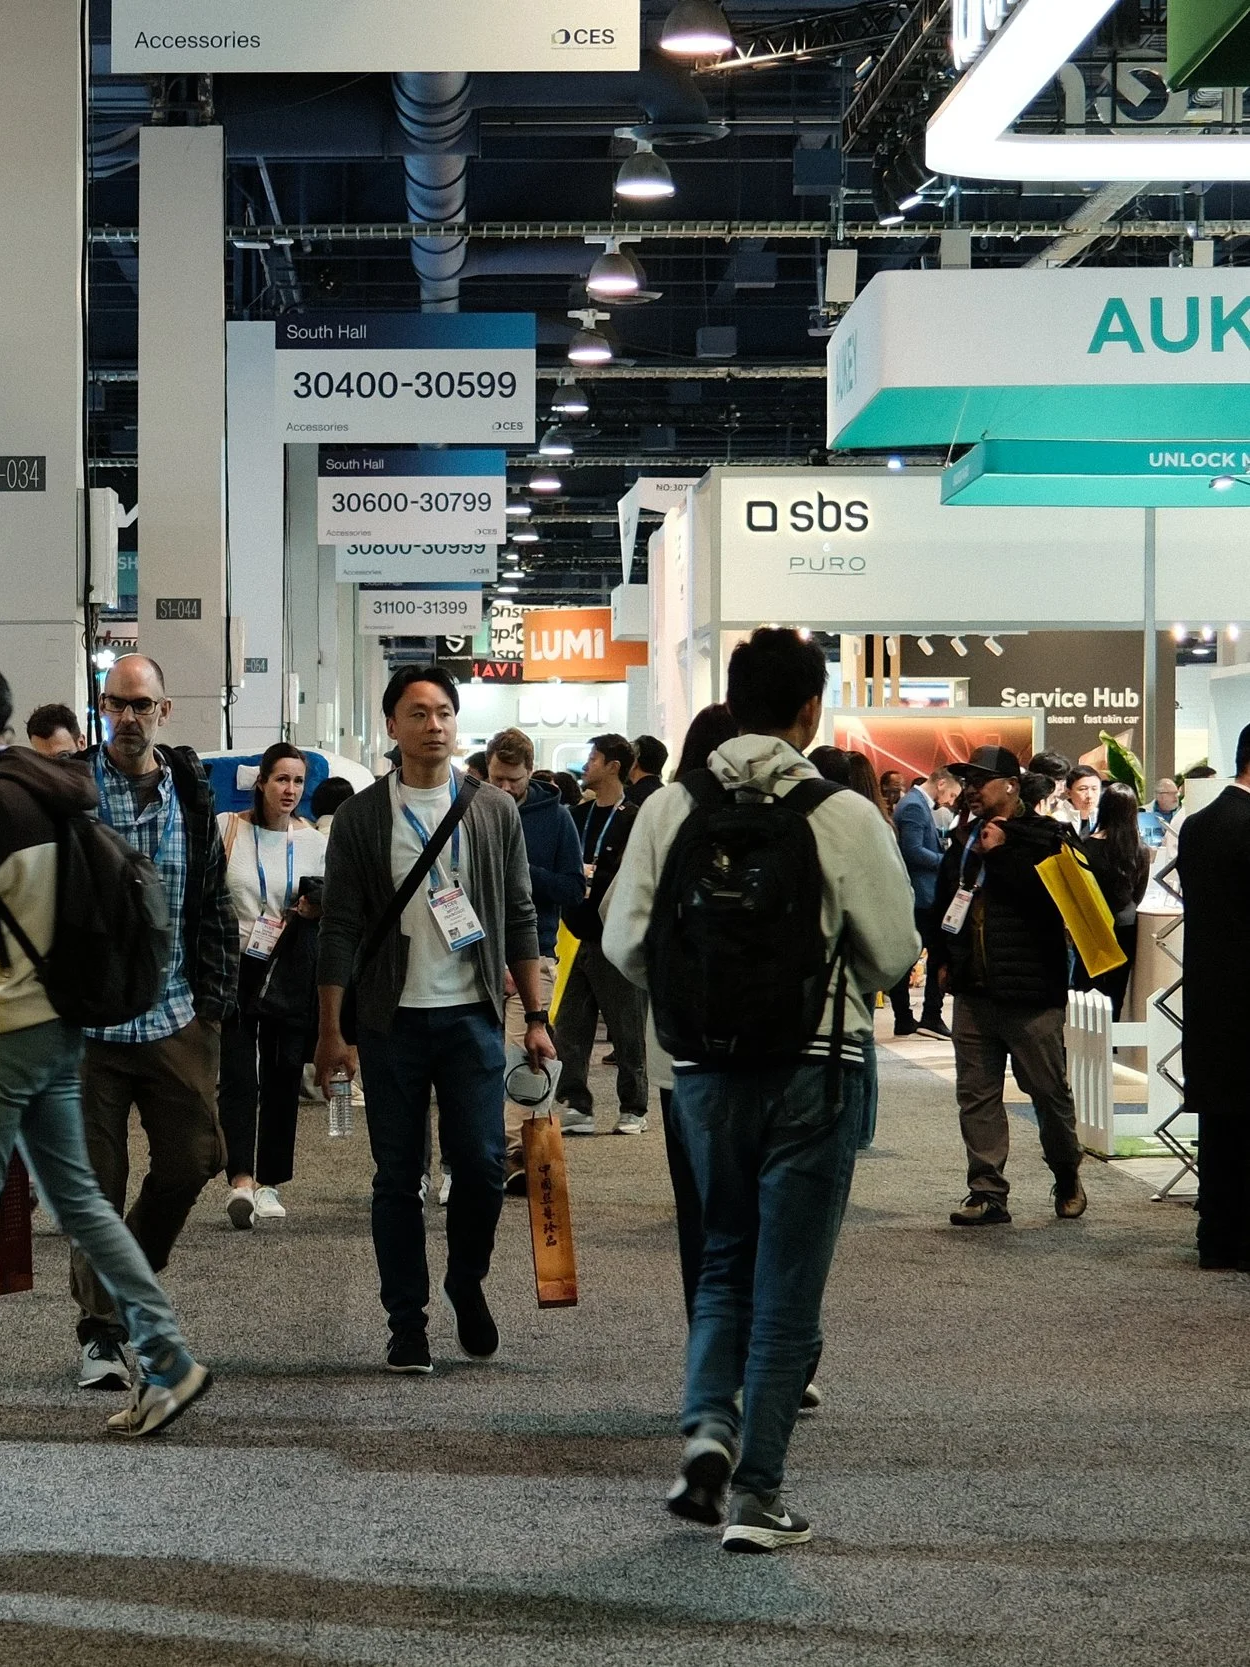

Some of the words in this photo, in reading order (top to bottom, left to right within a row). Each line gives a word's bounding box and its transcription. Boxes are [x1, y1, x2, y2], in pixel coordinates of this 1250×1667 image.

[134, 31, 261, 50] Accessories
[574, 29, 615, 44] CES
[286, 325, 333, 340] South
[338, 325, 367, 339] Hall
[293, 371, 517, 399] 30400-30599
[286, 422, 349, 433] Accessories
[503, 421, 523, 431] CES
[326, 459, 359, 471] South
[364, 458, 384, 469] Hall
[1149, 452, 1236, 468] UNLOCK
[332, 492, 492, 513] 30600-30799
[789, 490, 869, 532] sbs
[326, 529, 371, 537] Accessories
[790, 557, 866, 571] PURO
[159, 602, 197, 617] S1-044
[373, 601, 467, 614] 31100-31399
[530, 629, 605, 661] LUMI
[1001, 687, 1087, 708] Service
[1093, 687, 1139, 708] Hub
[1083, 714, 1102, 724] fast
